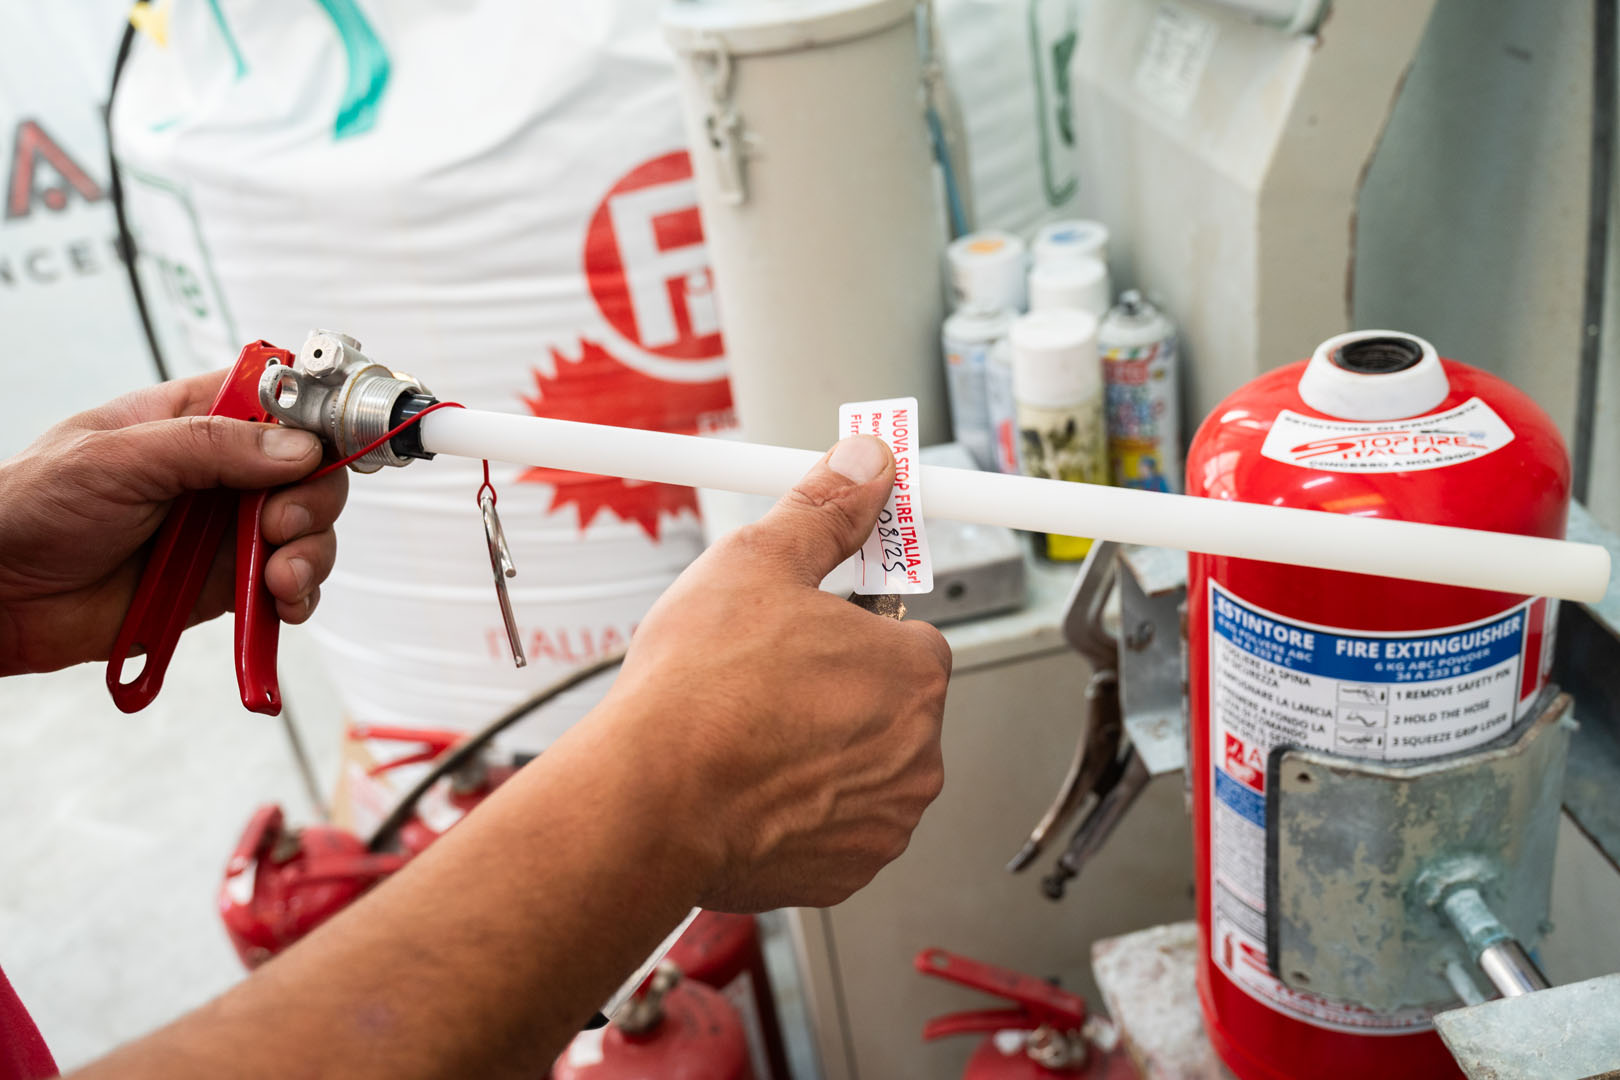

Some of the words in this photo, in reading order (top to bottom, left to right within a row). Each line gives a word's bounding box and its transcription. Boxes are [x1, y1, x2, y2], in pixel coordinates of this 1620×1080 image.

[892, 409, 908, 455] NUOVA
[893, 458, 910, 492] STOP
[895, 493, 913, 529] FIRE
[899, 526, 921, 572] ITALIA
[907, 570, 921, 584] srl
[1217, 596, 1315, 651] ESTINTORE
[1335, 639, 1380, 658] FIRE
[1385, 615, 1521, 659] EXTINGUISHER
[1374, 662, 1383, 671] 6
[1386, 661, 1405, 671] KG
[1408, 660, 1434, 670] ABC
[1438, 648, 1490, 668] POWDER
[1414, 670, 1425, 680] A
[1463, 663, 1472, 673] C
[1405, 686, 1454, 700] REMOVE
[1457, 675, 1493, 693] SAFETY
[1291, 700, 1333, 719] LANCIA
[1393, 715, 1400, 724] 2
[1403, 713, 1437, 725] HOLD
[1440, 709, 1461, 721] THE
[1463, 699, 1490, 716] HOSE
[1402, 732, 1452, 748] SQUEEZE
[1454, 725, 1479, 739] GRIP
[1480, 712, 1507, 733] LEVER
